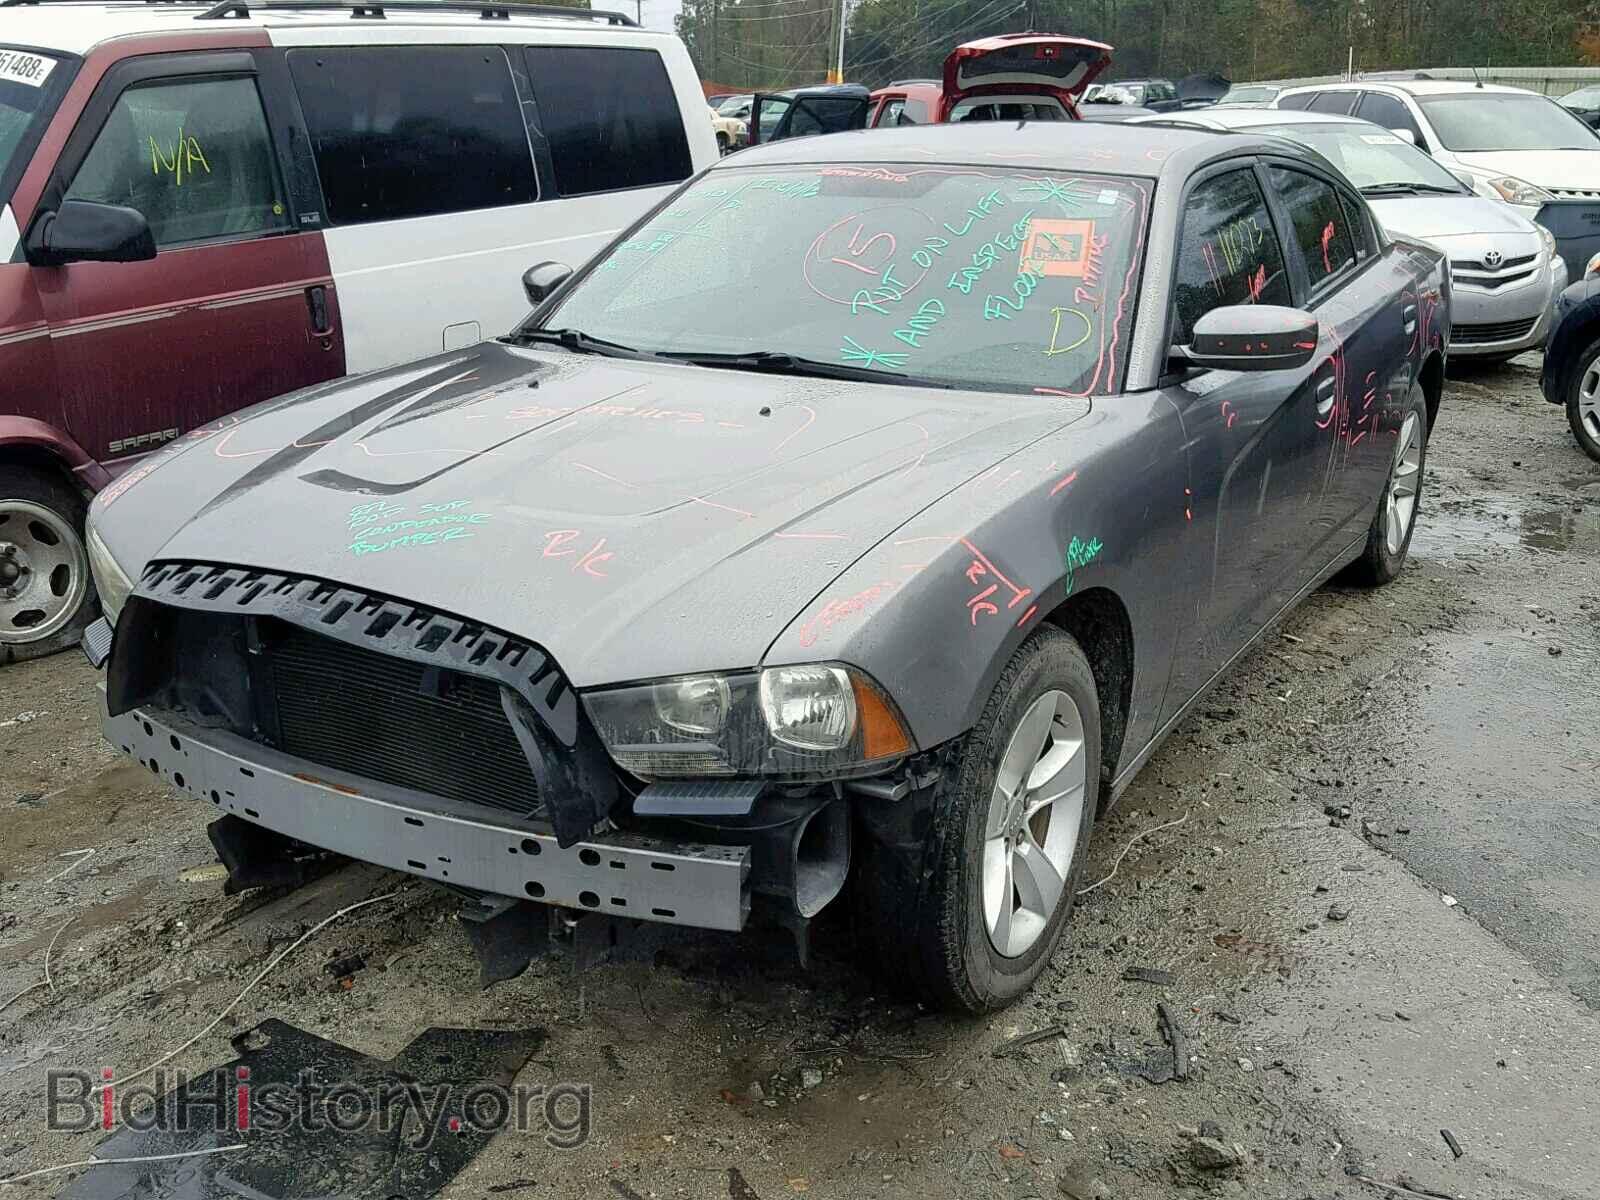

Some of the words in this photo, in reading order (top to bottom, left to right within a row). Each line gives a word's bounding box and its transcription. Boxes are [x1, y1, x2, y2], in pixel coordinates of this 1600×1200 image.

[0, 53, 44, 80] 51488E
[149, 127, 210, 185] N/A
[852, 264, 908, 315] PUT
[912, 236, 949, 268] ON
[943, 189, 1005, 237] LIFT
[893, 298, 945, 347] AND
[1043, 304, 1092, 359] D
[108, 427, 179, 453] SAFARI
